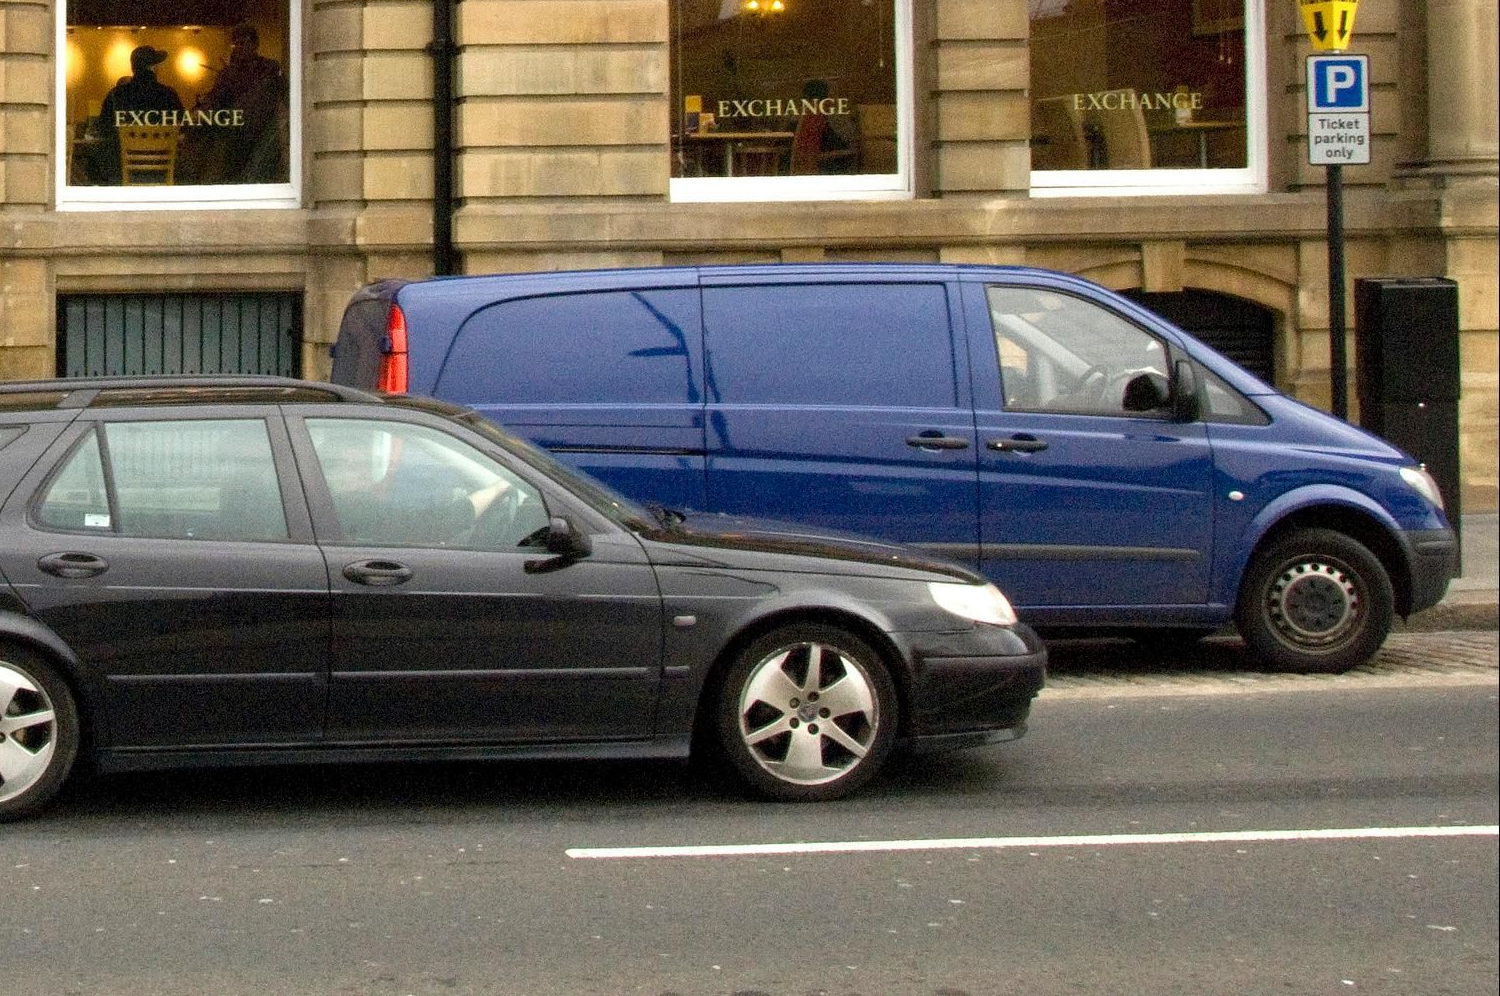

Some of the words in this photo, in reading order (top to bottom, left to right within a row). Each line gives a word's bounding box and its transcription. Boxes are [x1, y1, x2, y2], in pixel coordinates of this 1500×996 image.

[1326, 65, 1355, 103] P
[718, 98, 851, 118] EXCHANGE
[1073, 92, 1203, 111] EXCHANGE
[114, 109, 245, 127] EXCHANGE
[1318, 118, 1360, 130] Ticket
[1314, 133, 1365, 146] parking
[1325, 147, 1354, 160] only
